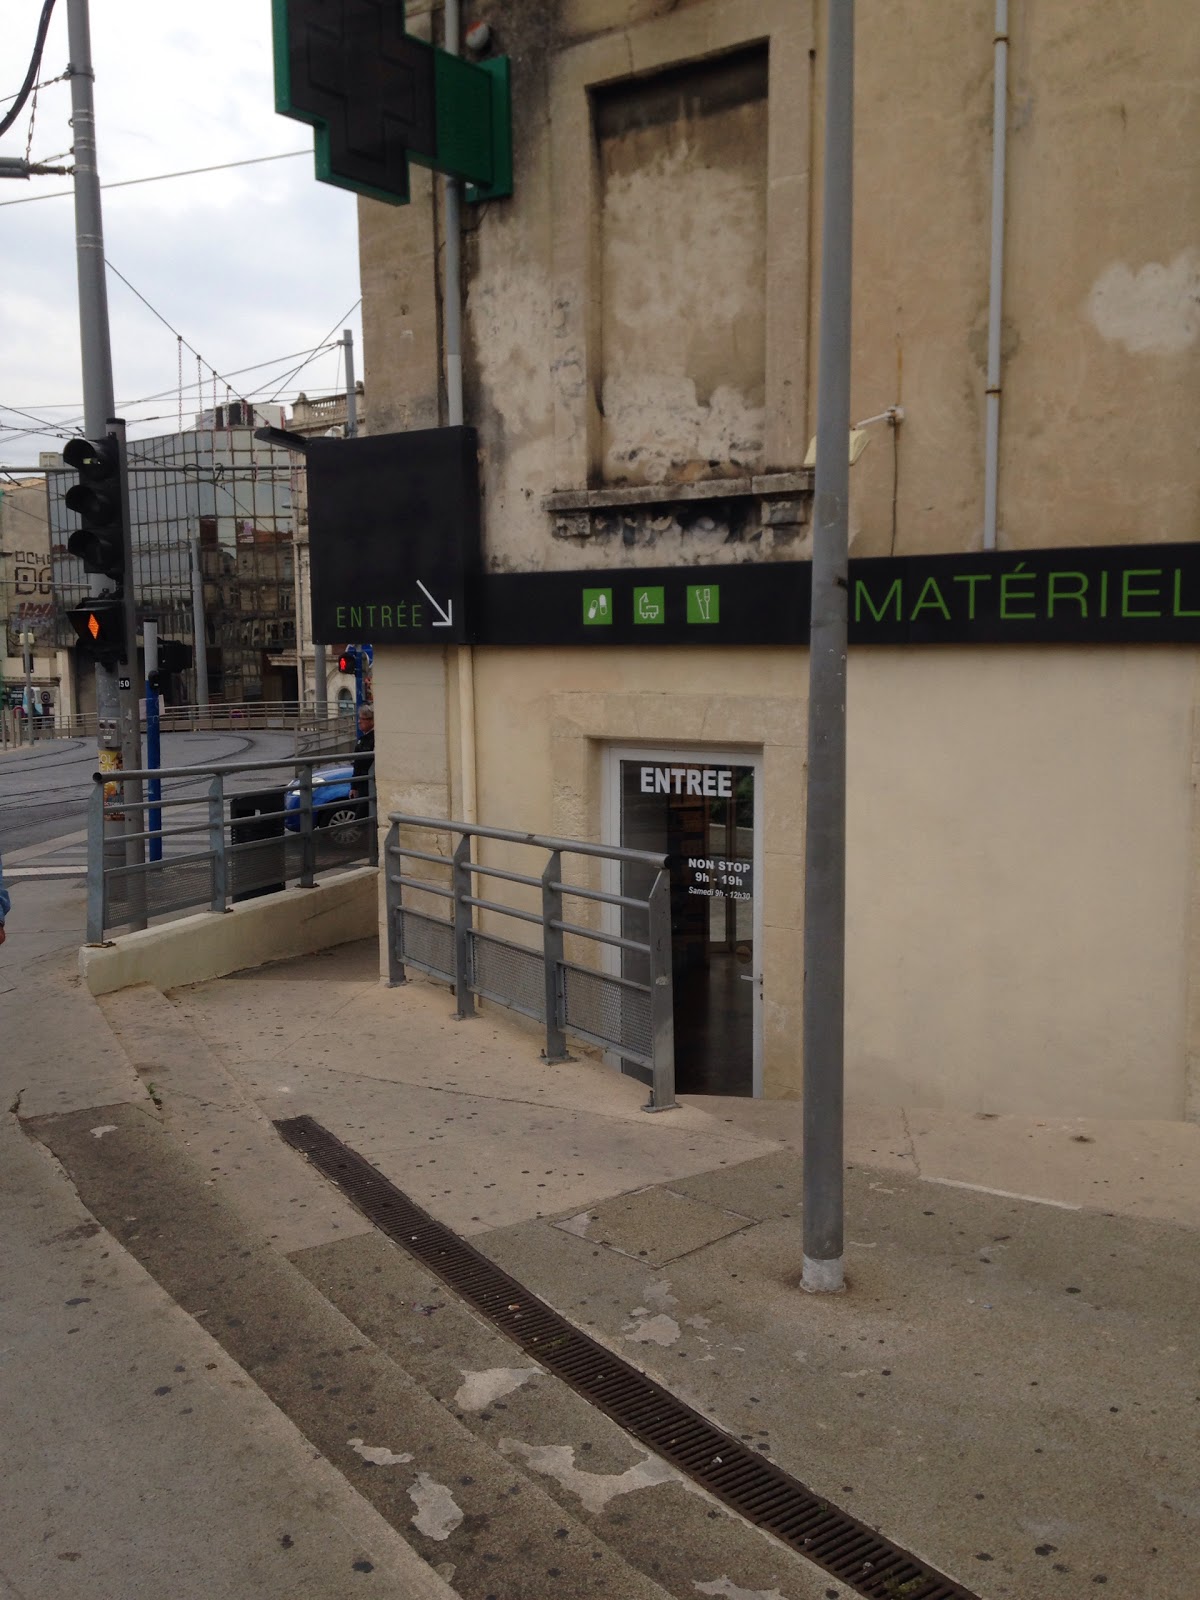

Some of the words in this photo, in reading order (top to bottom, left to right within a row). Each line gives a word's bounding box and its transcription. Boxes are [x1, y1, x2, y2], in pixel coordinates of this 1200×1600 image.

[854, 562, 1200, 622] MATÉRIEL
[336, 600, 422, 628] ENTRÉE
[640, 766, 732, 797] ENTREE
[688, 858, 715, 870] NON
[718, 861, 750, 873] STOP
[695, 872, 709, 883] 9h
[721, 875, 743, 886] 19h
[688, 886, 713, 896] Samedi
[715, 889, 724, 897] 9h
[730, 891, 751, 900] 12h30
